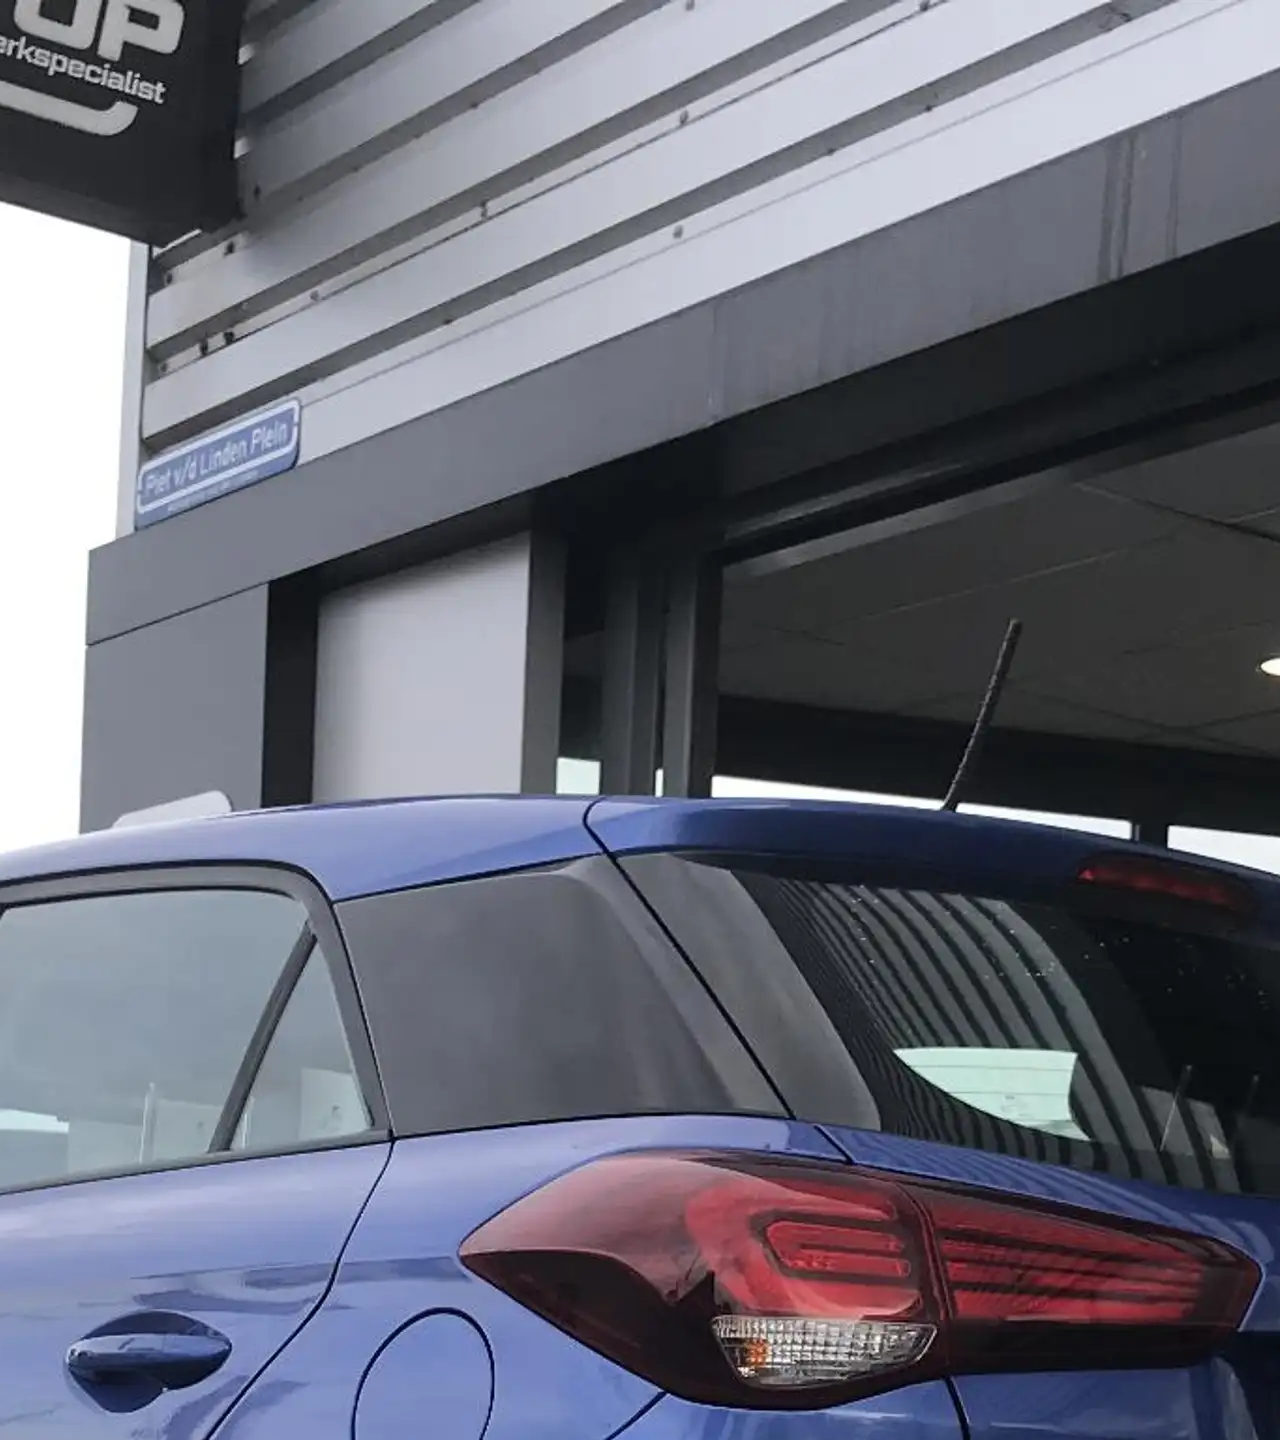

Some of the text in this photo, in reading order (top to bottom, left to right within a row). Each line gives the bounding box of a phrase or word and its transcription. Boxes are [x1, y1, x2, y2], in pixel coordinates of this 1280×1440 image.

[174, 453, 197, 487] v/d
[199, 440, 247, 475] Linden
[250, 420, 288, 454] Plein
